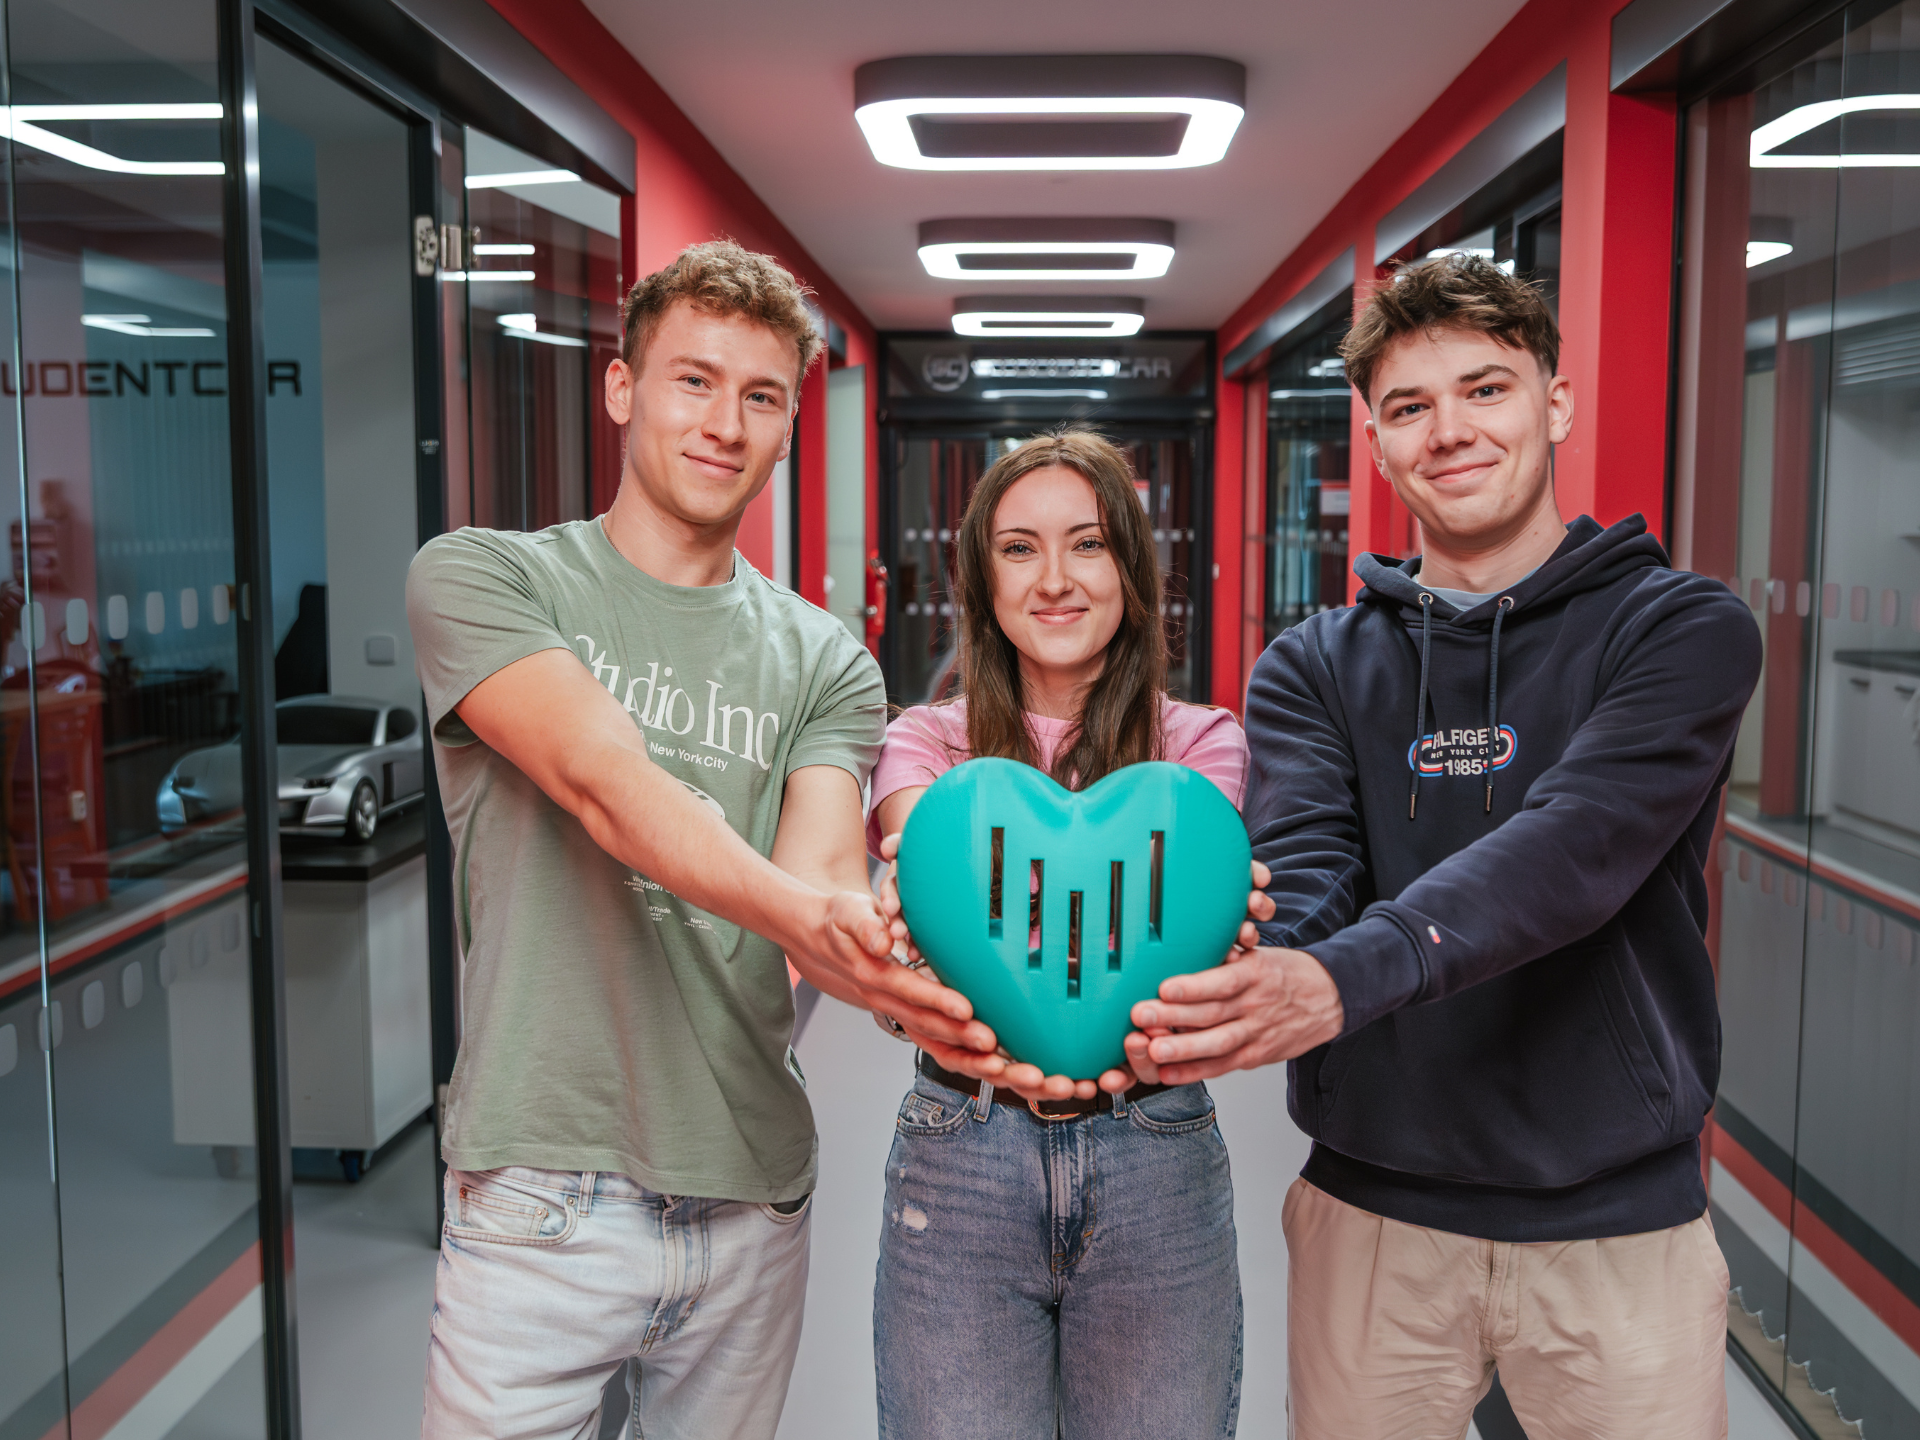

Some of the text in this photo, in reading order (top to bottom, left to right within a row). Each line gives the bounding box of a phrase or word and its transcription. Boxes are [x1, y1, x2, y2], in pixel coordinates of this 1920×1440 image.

[1, 360, 302, 397] UDENTCR
[649, 741, 728, 772] New York City
[1479, 745, 1499, 754] CIY
[1445, 759, 1483, 775] 1985
